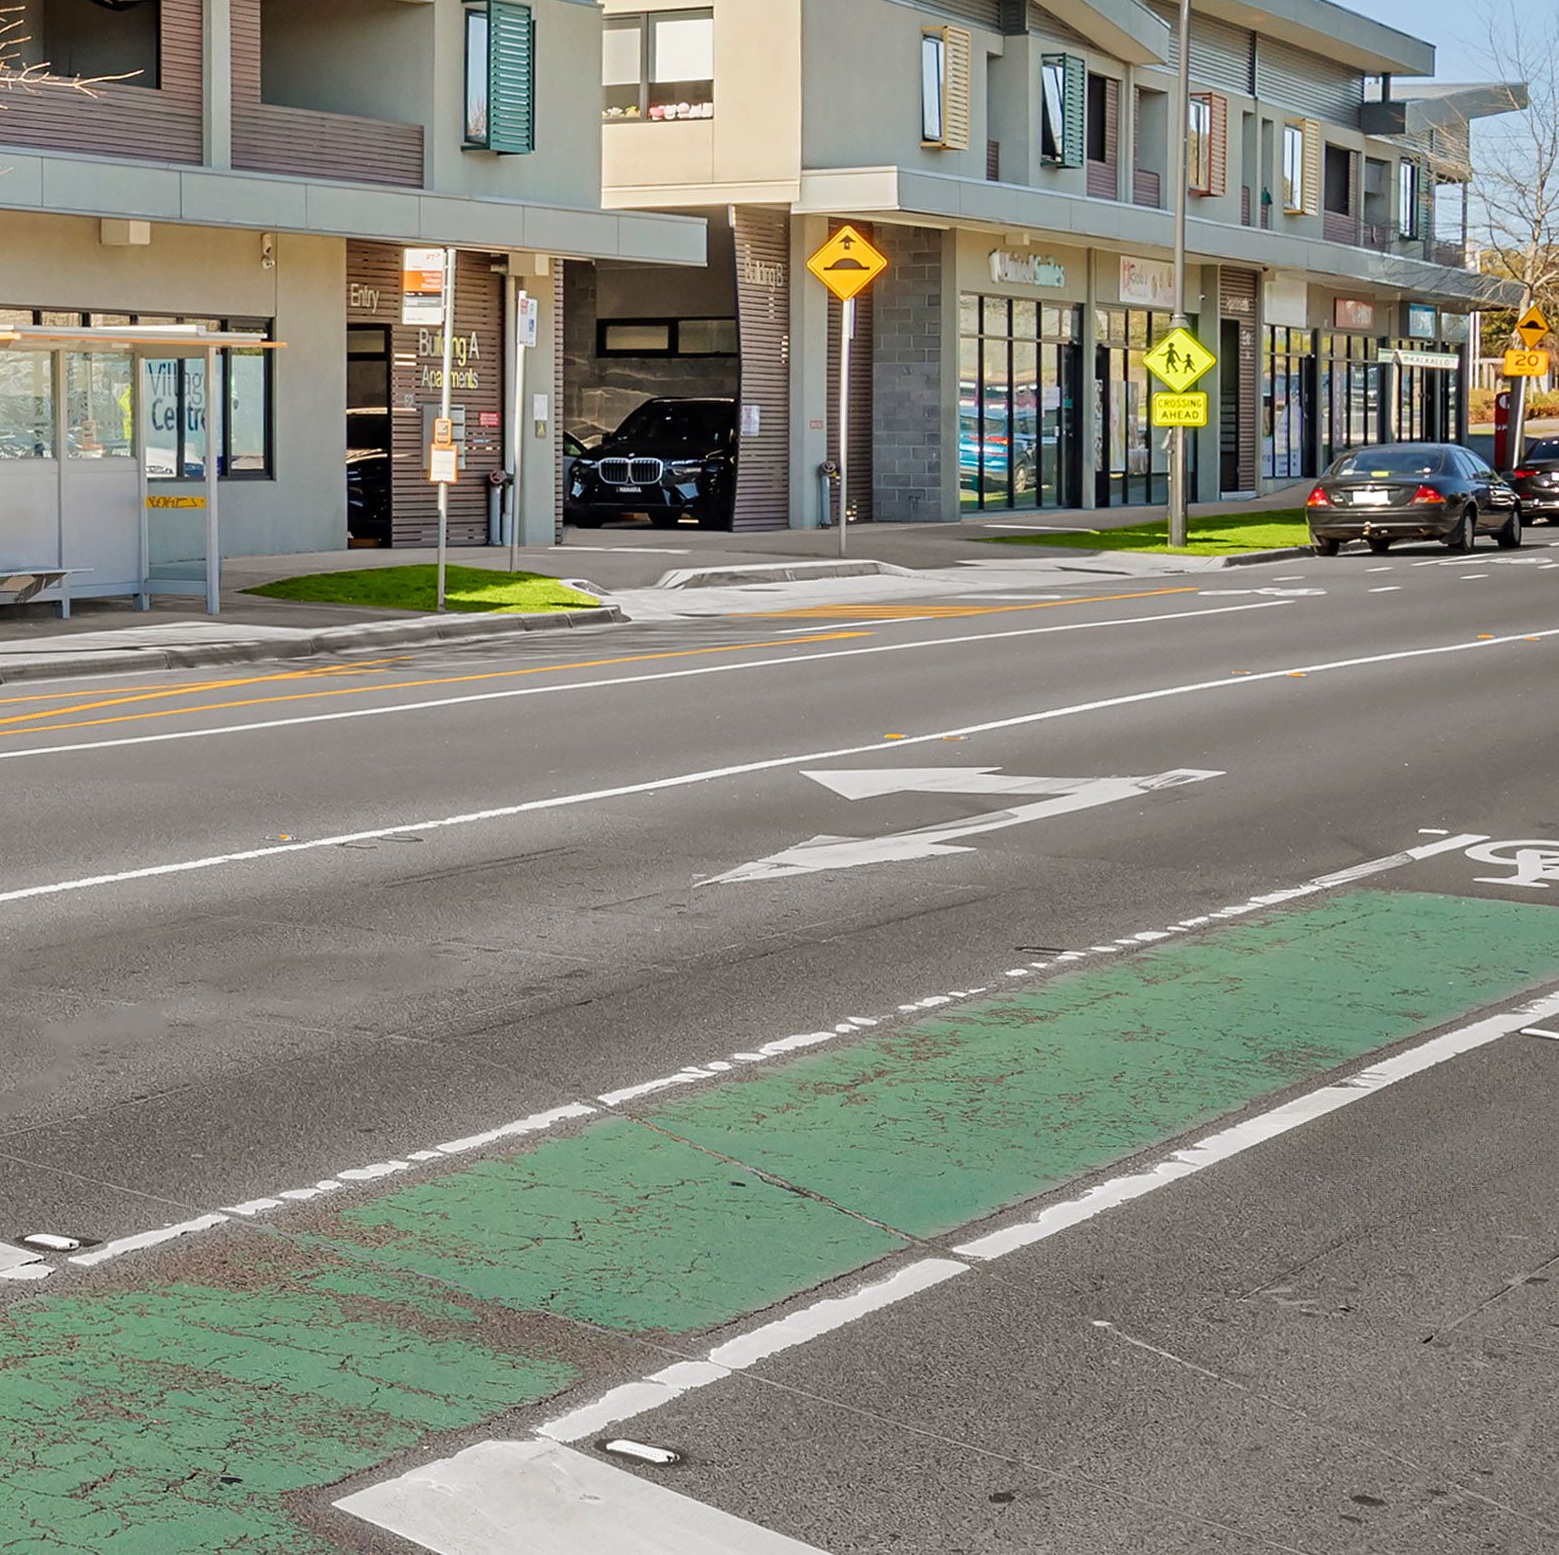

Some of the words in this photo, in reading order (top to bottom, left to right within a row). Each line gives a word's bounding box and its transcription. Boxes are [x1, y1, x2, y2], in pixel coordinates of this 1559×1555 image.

[351, 283, 379, 313] Entry
[468, 331, 480, 359] A
[1515, 354, 1539, 367] 20
[1158, 399, 1202, 408] CROSSING
[1162, 411, 1199, 419] AHEAD
